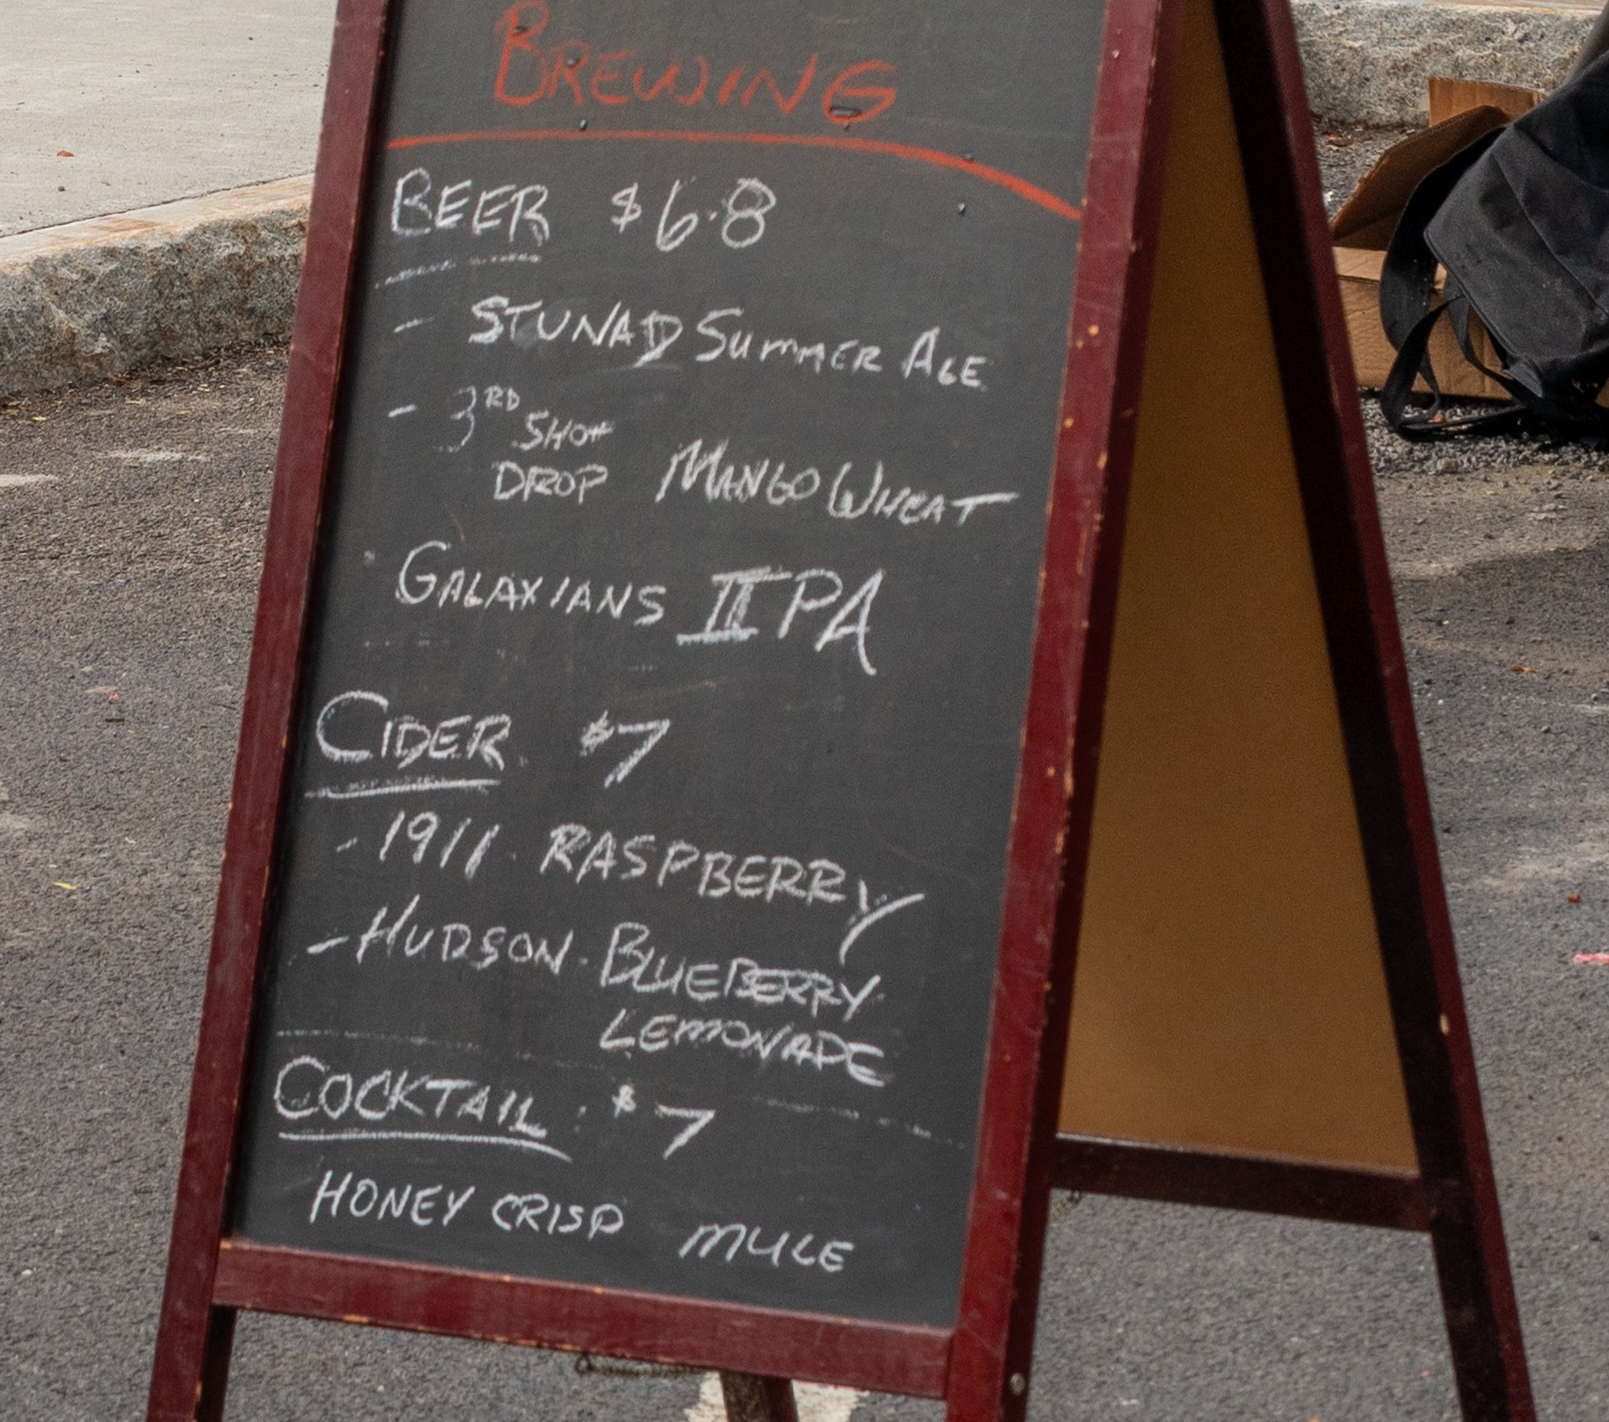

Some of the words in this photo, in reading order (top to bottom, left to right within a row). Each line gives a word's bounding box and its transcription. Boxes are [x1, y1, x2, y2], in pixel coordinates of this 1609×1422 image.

[494, 1, 898, 123] BREWING
[391, 166, 552, 246] BEER
[468, 294, 682, 371] STUNAD
[902, 326, 987, 391] ALE
[492, 461, 609, 506] DROP
[655, 439, 821, 505] MANGO
[395, 540, 667, 625] GALAXIANS
[314, 691, 513, 770] CIDER
[578, 710, 673, 789] $7
[356, 894, 575, 975] HUDSON
[378, 811, 501, 879] 1911
[539, 823, 925, 964] RASPBERRY
[598, 1008, 897, 1087] LEMONADE
[272, 1055, 551, 1140] COCKTAIL
[610, 1083, 717, 1161] $7
[309, 1170, 476, 1225] HONEY
[492, 1192, 625, 1241] CRISP
[679, 1222, 855, 1274] MULE
